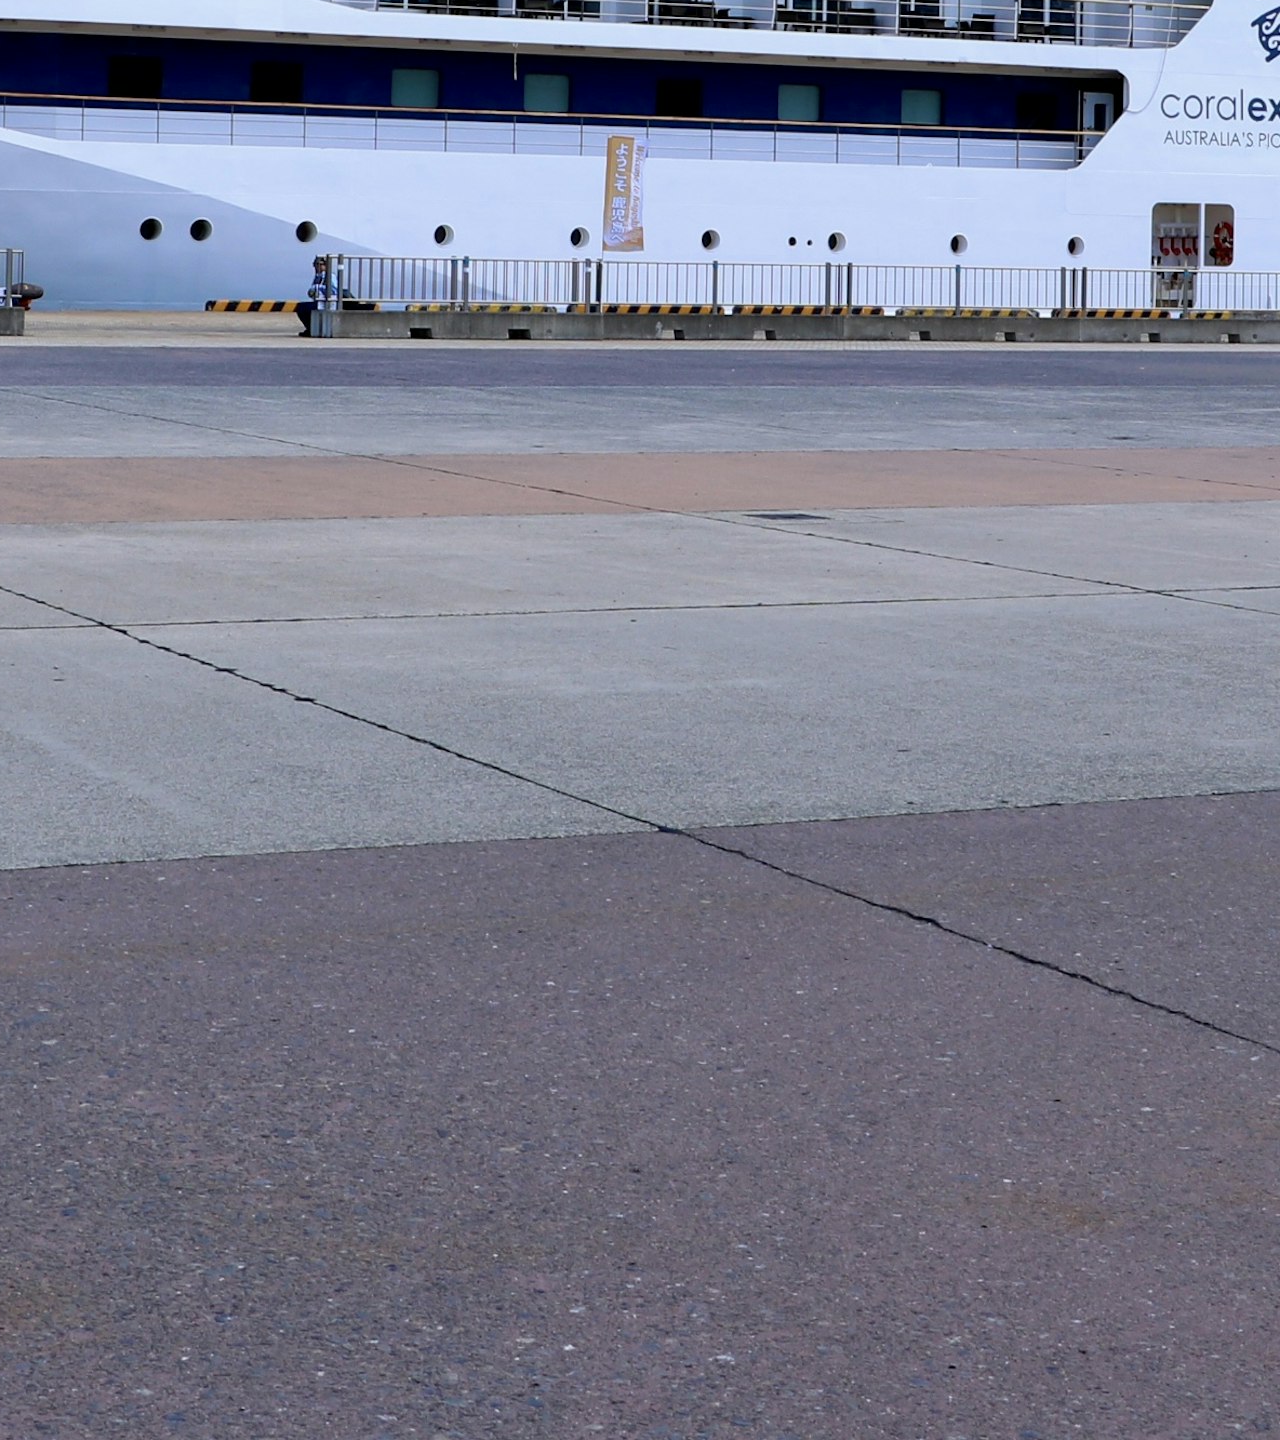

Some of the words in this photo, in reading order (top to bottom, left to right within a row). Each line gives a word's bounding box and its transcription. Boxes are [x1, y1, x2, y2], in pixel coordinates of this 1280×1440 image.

[1164, 130, 1254, 148] AUSTRALIA'S
[614, 143, 629, 192] ようこそ
